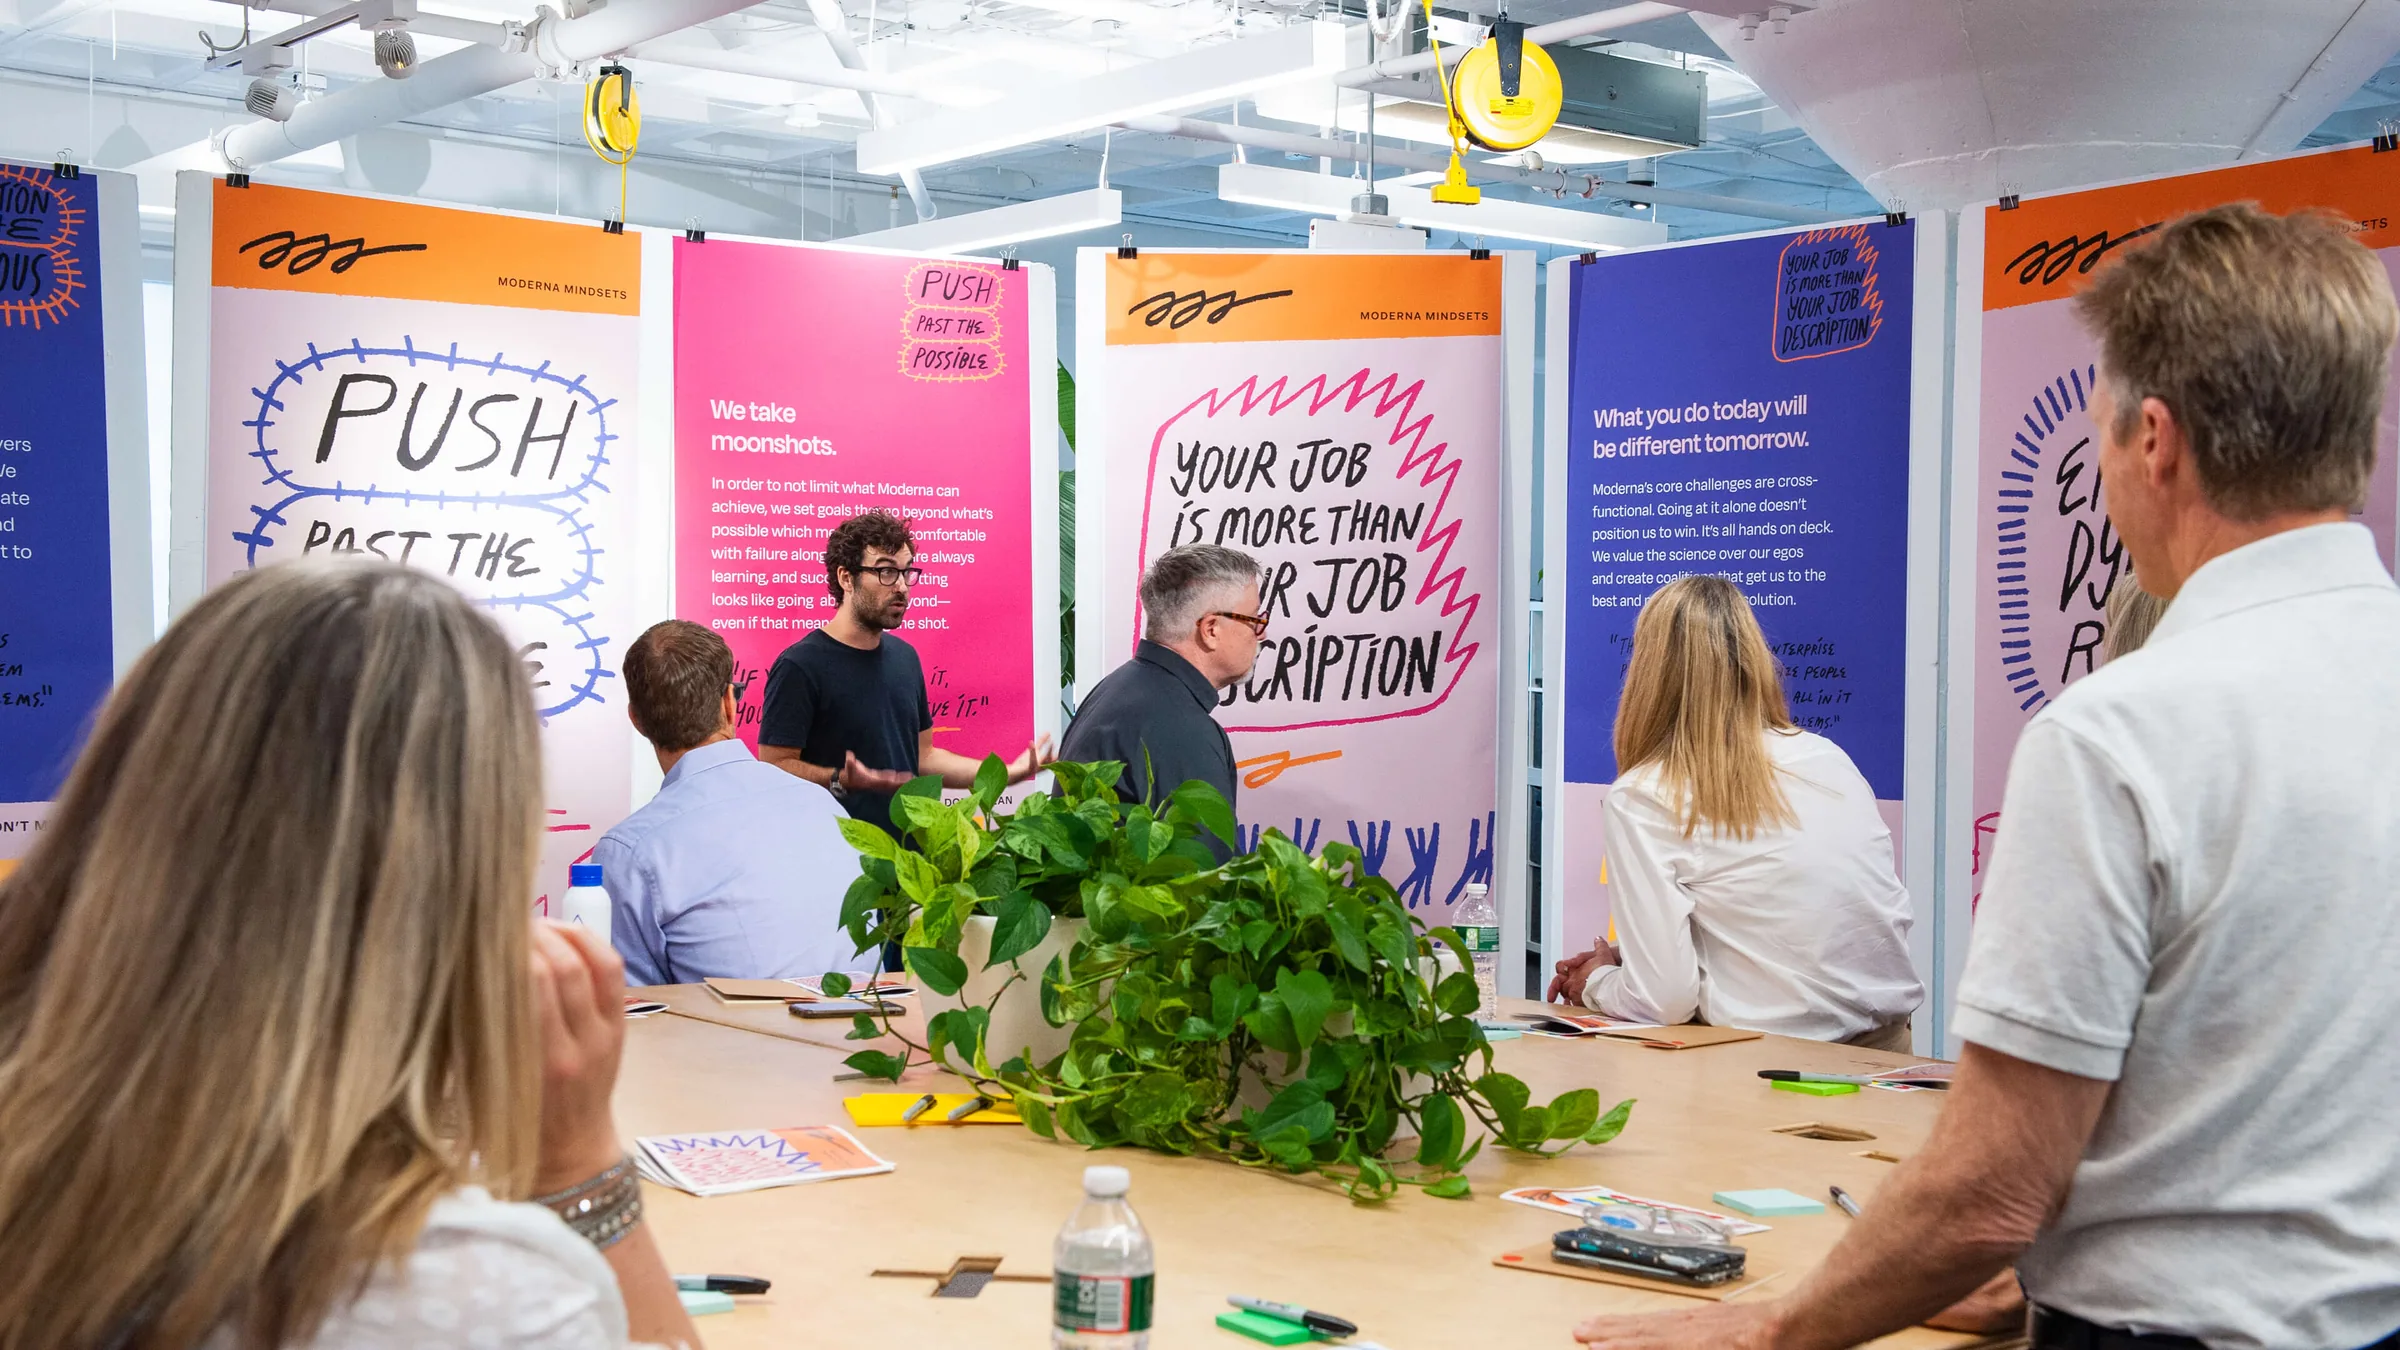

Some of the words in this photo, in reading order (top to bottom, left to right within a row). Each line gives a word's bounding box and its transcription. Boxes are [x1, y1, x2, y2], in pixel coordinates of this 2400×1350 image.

[1785, 251, 1820, 275] YOUR
[1823, 248, 1849, 270] JOB
[498, 276, 560, 292] MODERNA
[564, 284, 627, 300] MINDSETS
[920, 270, 993, 304] PUSH
[1785, 275, 1798, 294] IS
[1799, 274, 1832, 292] MORE
[1834, 268, 1866, 287] THAN
[1787, 295, 1825, 321] YOUR
[1827, 288, 1860, 314] JOB
[917, 315, 954, 334] PAST
[958, 319, 985, 335] THE
[1360, 311, 1421, 321] MODERNA
[1425, 311, 1489, 321] MINDSETS
[1782, 315, 1870, 355] DESCRIPTION
[913, 346, 988, 370] POSSIBLE
[710, 399, 746, 420] We
[749, 401, 796, 423] take
[1593, 407, 1643, 428] What
[1645, 409, 1681, 430] you
[1684, 403, 1709, 422] do
[1712, 399, 1771, 423] today
[1774, 395, 1808, 416] will
[315, 373, 578, 480] PUSH
[711, 434, 837, 456] moonshots.
[1593, 440, 1616, 459] be
[1619, 435, 1701, 458] different
[1704, 430, 1809, 453] tomorrow.
[1170, 440, 1277, 497] YOUR
[1290, 439, 1371, 493] JOB
[712, 477, 724, 490] In
[727, 477, 764, 491] order
[766, 479, 781, 492] to
[784, 479, 807, 492] not
[809, 480, 839, 494] limit
[841, 481, 875, 495] what
[878, 482, 933, 497] Moderna
[936, 485, 959, 497] can
[1593, 481, 1653, 496] Moderna's
[1655, 481, 1683, 494] core
[1686, 476, 1752, 493] challenges
[1754, 478, 1775, 489] are
[1778, 475, 1818, 488] cross-
[712, 500, 767, 516] achieve,
[770, 505, 791, 515] we
[794, 503, 814, 516] set
[817, 503, 851, 519] goals
[902, 505, 949, 522] beyond
[952, 506, 993, 520] what's
[1592, 504, 1655, 518] functional.
[1658, 503, 1693, 518] Going
[1695, 502, 1708, 514] at
[1711, 502, 1719, 514] it
[1722, 501, 1756, 513] alone
[1759, 498, 1806, 512] doesn't
[712, 524, 768, 540] possible
[772, 525, 812, 539] which
[1215, 504, 1317, 547] MORE
[1328, 500, 1425, 546] THAN
[1592, 527, 1639, 542] position
[1642, 529, 1656, 540] us
[1659, 527, 1672, 539] to
[1674, 526, 1699, 538] win.
[1701, 524, 1719, 537] It's
[1722, 523, 1735, 536] all
[1739, 522, 1777, 536] hands
[1780, 523, 1796, 535] on
[1799, 520, 1833, 534] deck.
[12, 544, 32, 559] to
[447, 532, 540, 581] THE
[712, 547, 742, 560] with
[745, 547, 788, 561] failure
[931, 550, 975, 566] always
[1592, 551, 1610, 563] We
[1613, 549, 1644, 562] value
[1647, 549, 1666, 561] the
[1669, 548, 1716, 561] science
[1719, 549, 1747, 560] over
[1750, 548, 1770, 559] our
[1773, 547, 1804, 561] egos
[712, 570, 769, 587] learning,
[772, 571, 797, 584] and
[1306, 553, 1408, 618] JOB
[1592, 572, 1613, 585] and
[1616, 573, 1653, 585] create
[1746, 570, 1766, 585] get
[1769, 572, 1785, 583] us
[1787, 570, 1802, 582] to
[1805, 569, 1827, 582] the
[712, 593, 748, 606] looks
[751, 593, 774, 606] like
[777, 594, 813, 611] going
[1592, 595, 1617, 607] best
[1620, 595, 1641, 607] and
[712, 618, 745, 630] even
[749, 617, 758, 630] if
[761, 617, 788, 630] that
[918, 617, 949, 630] shot.
[1804, 665, 1847, 680] PEOPLE
[1793, 691, 1813, 704] ALL
